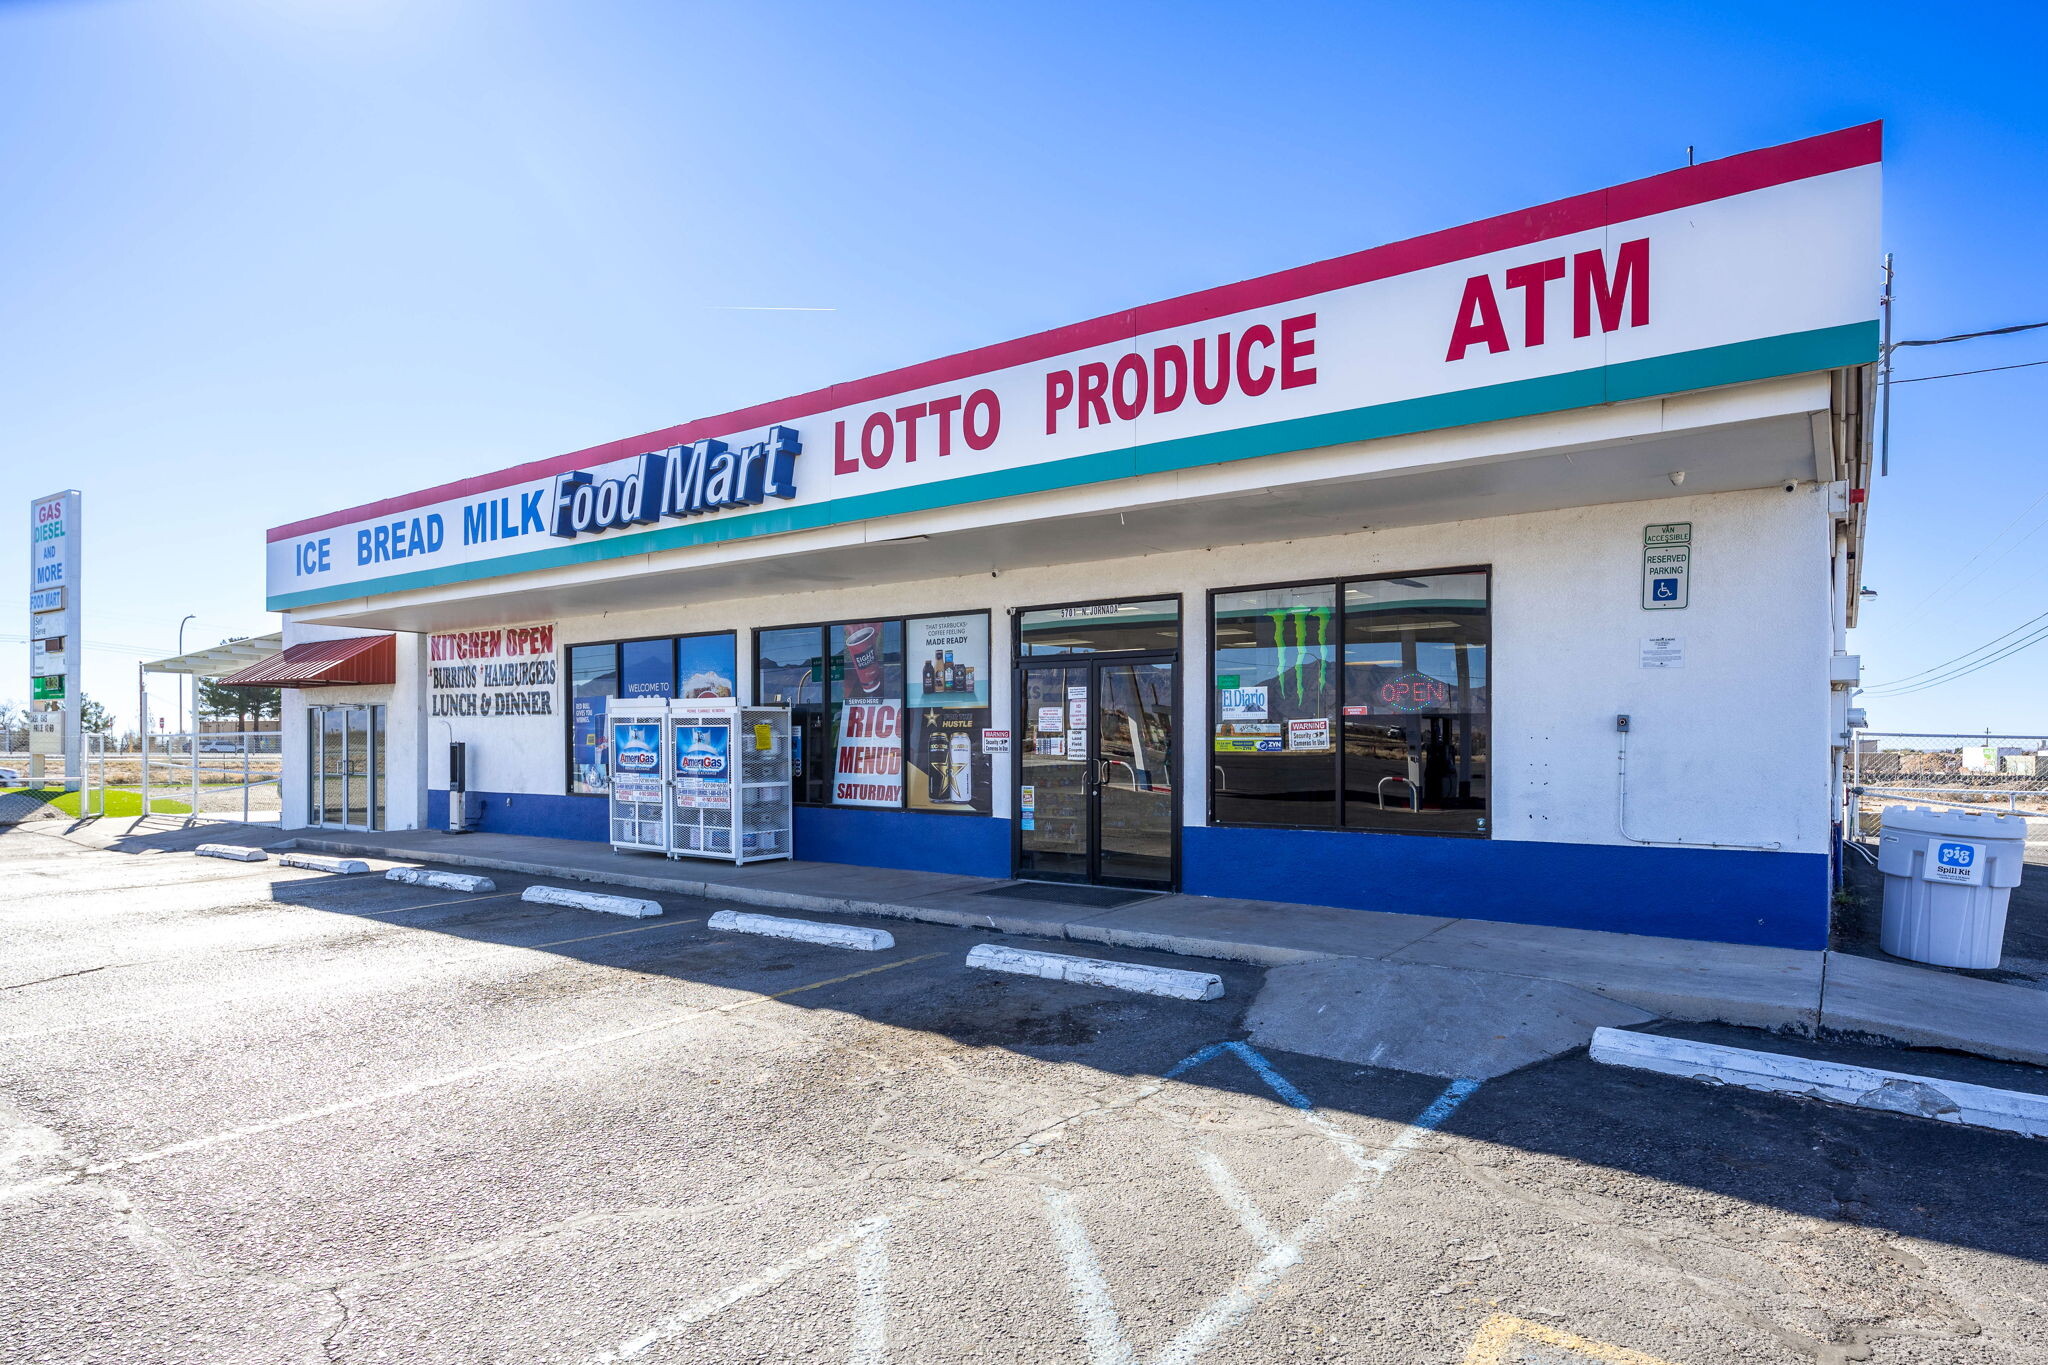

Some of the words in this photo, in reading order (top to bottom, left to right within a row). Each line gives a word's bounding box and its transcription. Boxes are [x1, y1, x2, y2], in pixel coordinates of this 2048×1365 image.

[1445, 238, 1651, 362] ATM
[835, 388, 1001, 476] LOTTO
[1046, 312, 1318, 434] PRODUCE
[550, 453, 647, 538] Food
[661, 425, 794, 517] Mart
[39, 502, 61, 523] GAS
[35, 520, 65, 543] DIESEL
[296, 538, 331, 577] ICE
[357, 513, 444, 567] BREAD
[463, 489, 546, 546] MILK
[1647, 533, 1688, 541] ACCESSIBLE
[43, 545, 56, 560] AND
[1647, 554, 1686, 563] RESERVED
[37, 562, 62, 584] MORE
[1649, 566, 1683, 575] PARKING
[45, 591, 60, 607] MART
[1061, 608, 1076, 618] 5701
[1090, 604, 1119, 616] JORNADA
[430, 629, 502, 662] KITCHEN
[506, 624, 554, 657] OPEN
[926, 638, 945, 646] MADE
[946, 636, 968, 645] READY
[433, 664, 477, 690] BURRITOS
[483, 660, 556, 688] HAMBURGERS
[628, 682, 659, 693] WELCOME
[660, 682, 670, 691] TO
[1382, 682, 1444, 702] OPEN
[431, 693, 477, 717] LUNCH
[480, 692, 492, 717] &
[494, 690, 553, 716] DINNER
[1223, 690, 1232, 707] El
[1234, 689, 1265, 707] Diario
[1292, 721, 1326, 730] WARNING
[1293, 732, 1312, 740] Security
[621, 753, 655, 764] AmeriGas
[682, 756, 723, 768] AmeriGas
[836, 782, 902, 802] SATURDAY
[1942, 846, 1971, 864] pig
[1937, 865, 1957, 875] Spill
[1958, 868, 1971, 876] Kit
